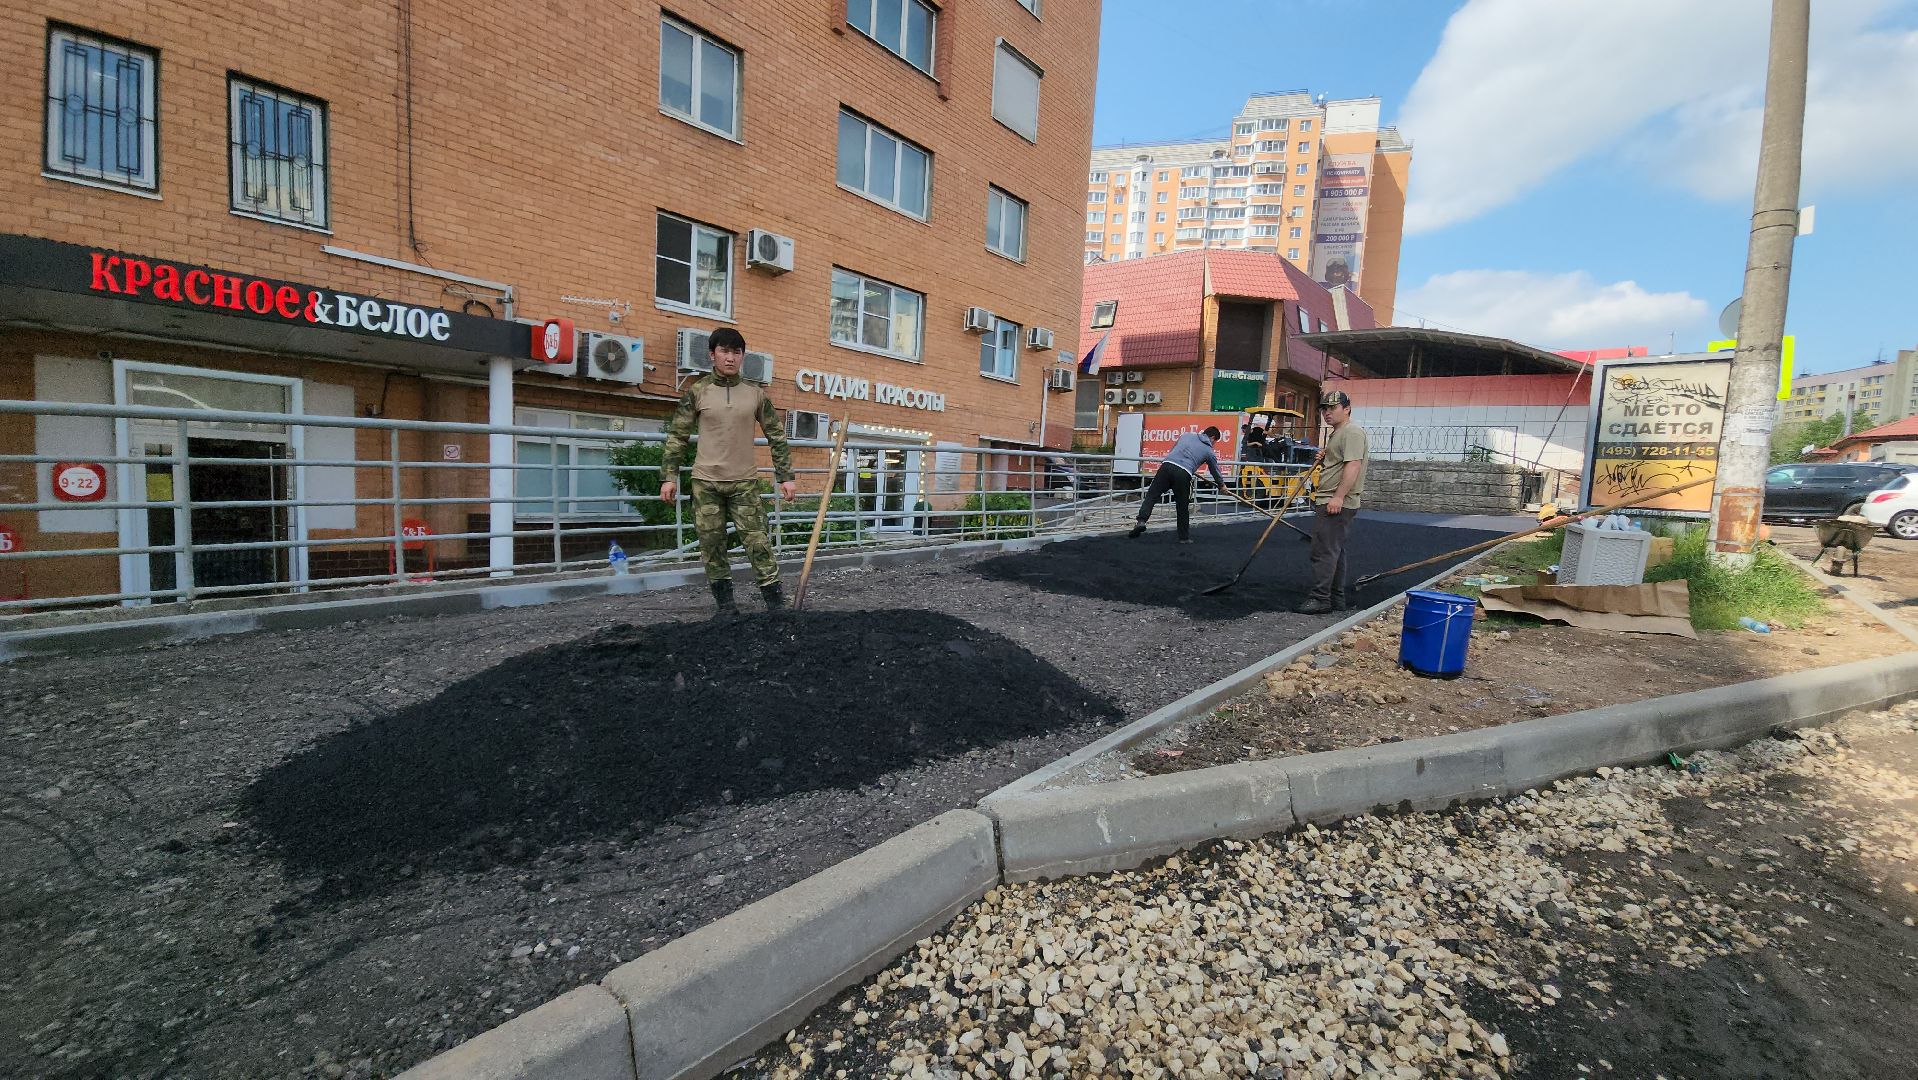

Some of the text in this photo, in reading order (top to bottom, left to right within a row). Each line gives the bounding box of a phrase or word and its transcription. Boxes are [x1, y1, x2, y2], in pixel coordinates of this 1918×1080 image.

[1330, 189, 1343, 197] 905
[795, 367, 945, 413] СТУДИЯ КРАСОТЫ
[1623, 403, 1702, 417] МЕСТО
[1608, 420, 1714, 437] СДАЁТСЯ
[1600, 446, 1716, 457] (495) 728-11-55
